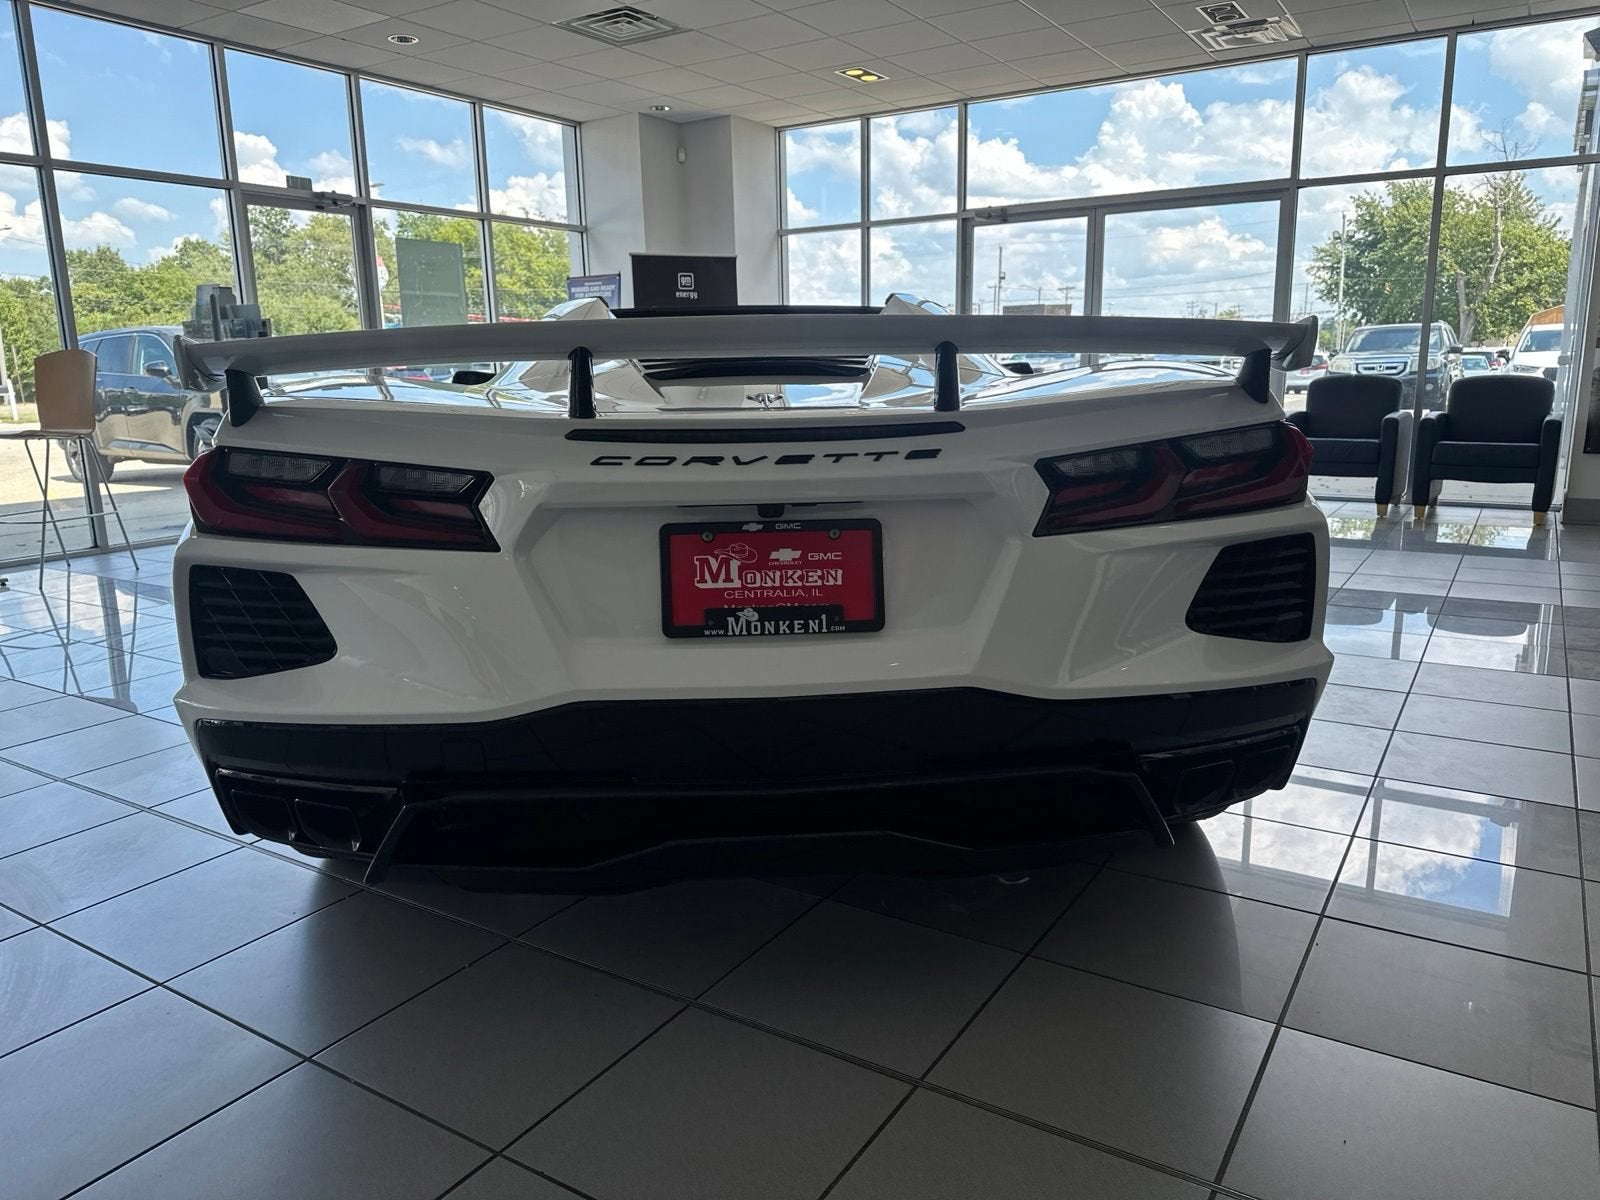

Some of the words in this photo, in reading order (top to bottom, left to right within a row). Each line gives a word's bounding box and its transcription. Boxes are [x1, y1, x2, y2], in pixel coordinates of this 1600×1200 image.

[675, 291, 698, 300] energy
[590, 448, 943, 467] CORVETTE
[775, 522, 802, 530] GMC
[808, 552, 842, 560] GMC
[694, 555, 843, 589] MONKEN
[724, 589, 808, 599] CENTRALIA,
[812, 588, 823, 597] IL
